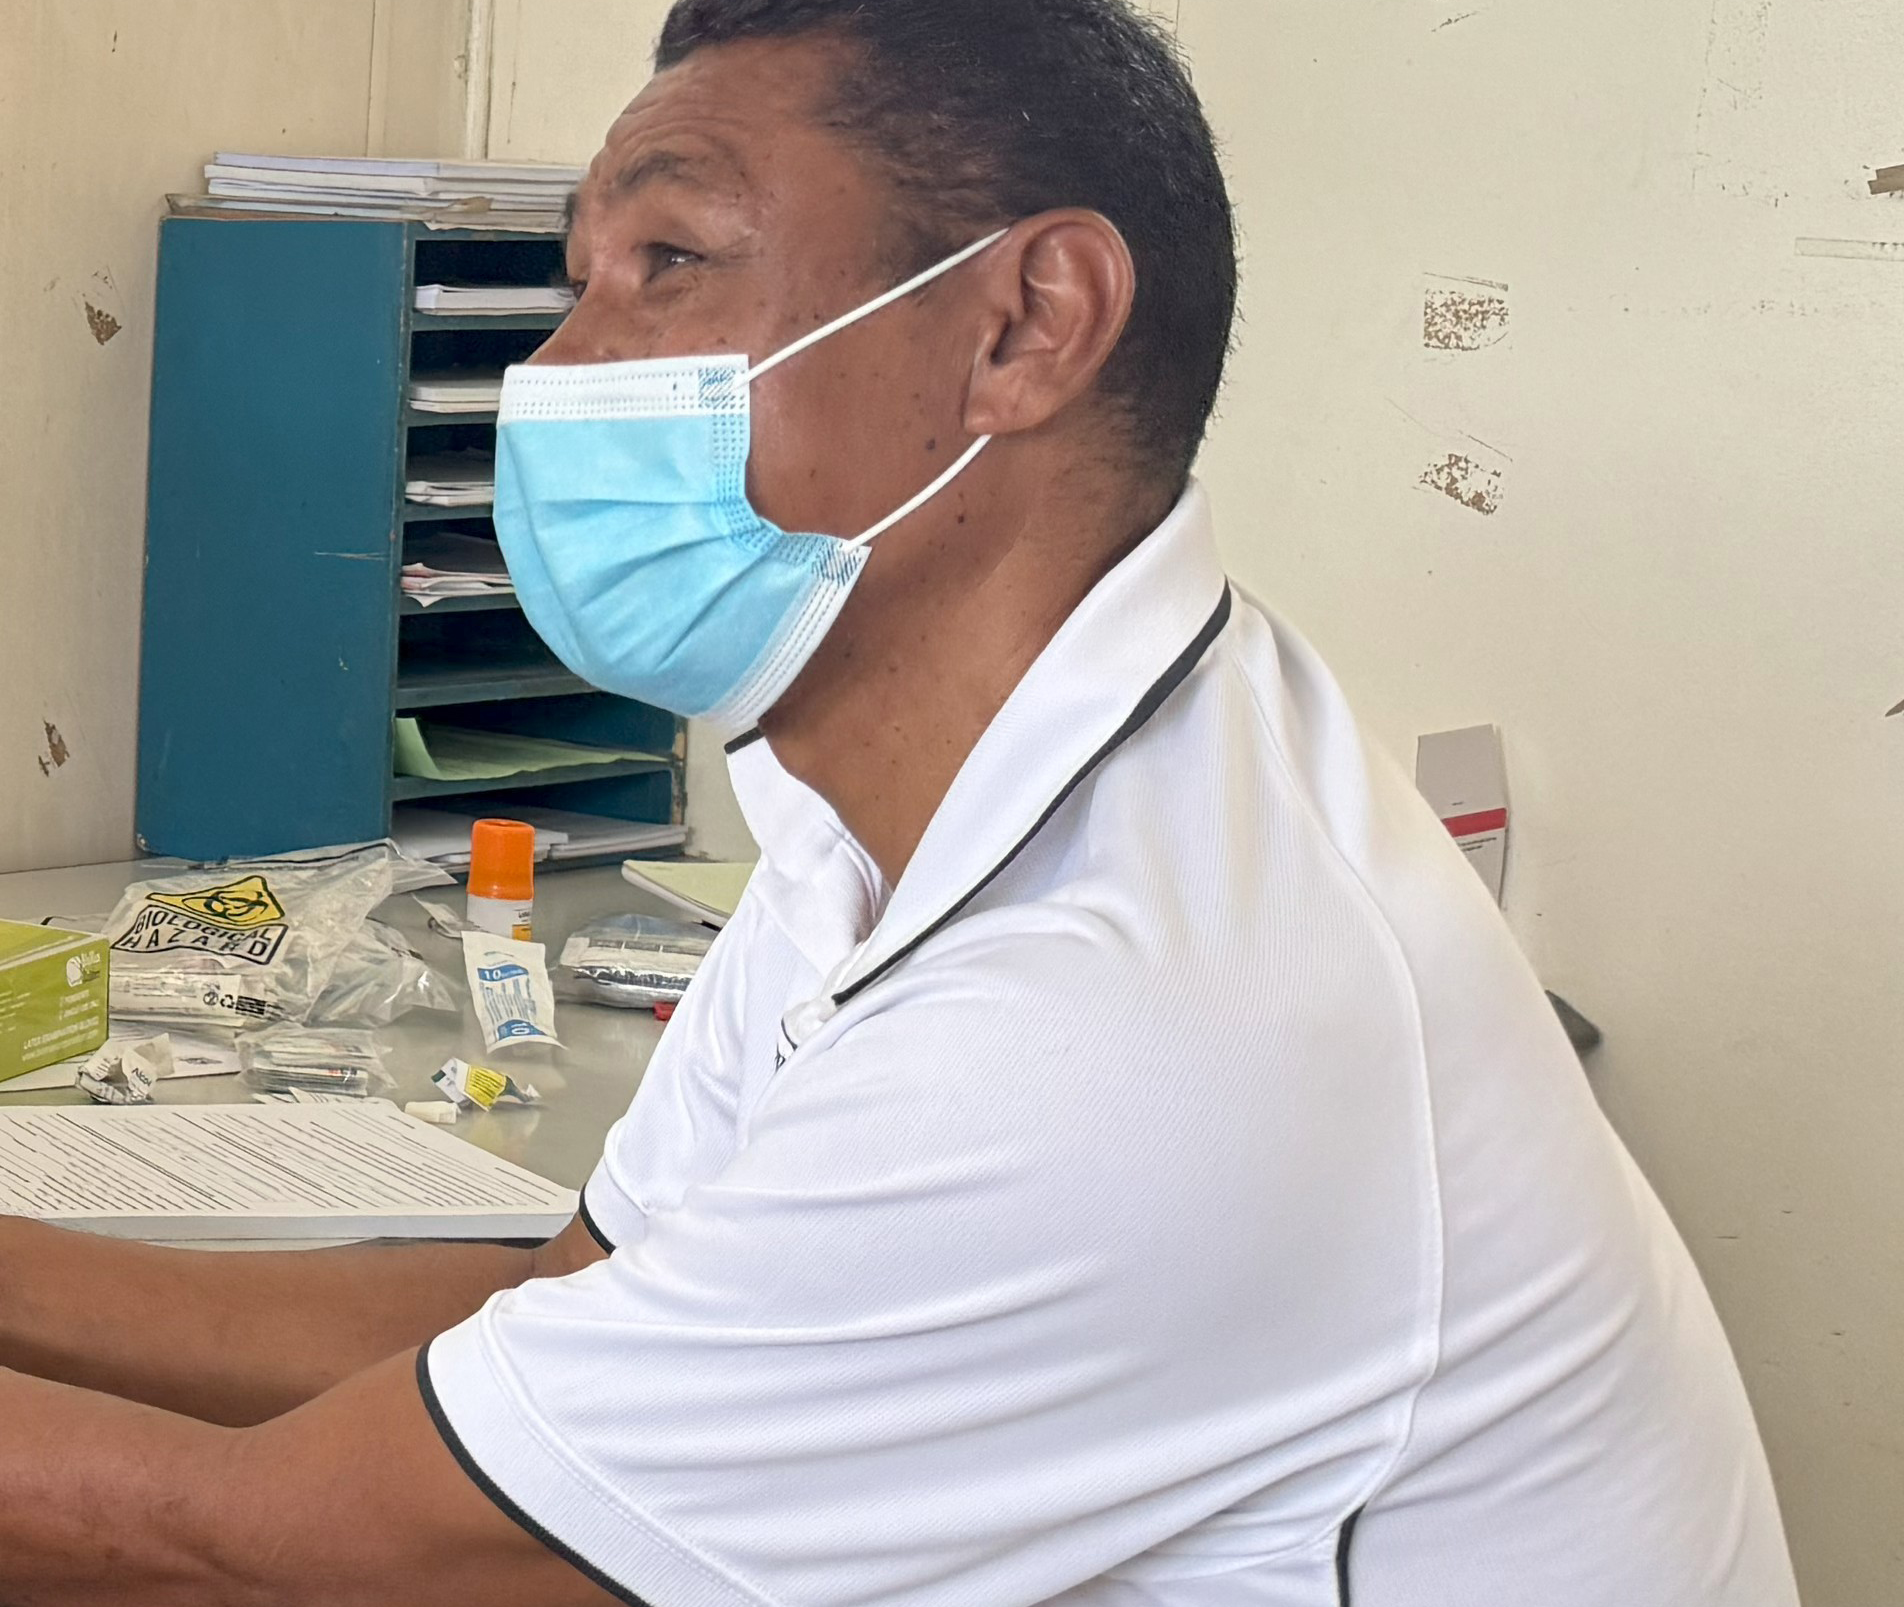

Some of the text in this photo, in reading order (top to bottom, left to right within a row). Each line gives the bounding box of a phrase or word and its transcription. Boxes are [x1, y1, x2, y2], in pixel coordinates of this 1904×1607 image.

[134, 909, 272, 943] BIOLOGICAL
[122, 928, 269, 956] HAZARD
[484, 969, 501, 980] 10
